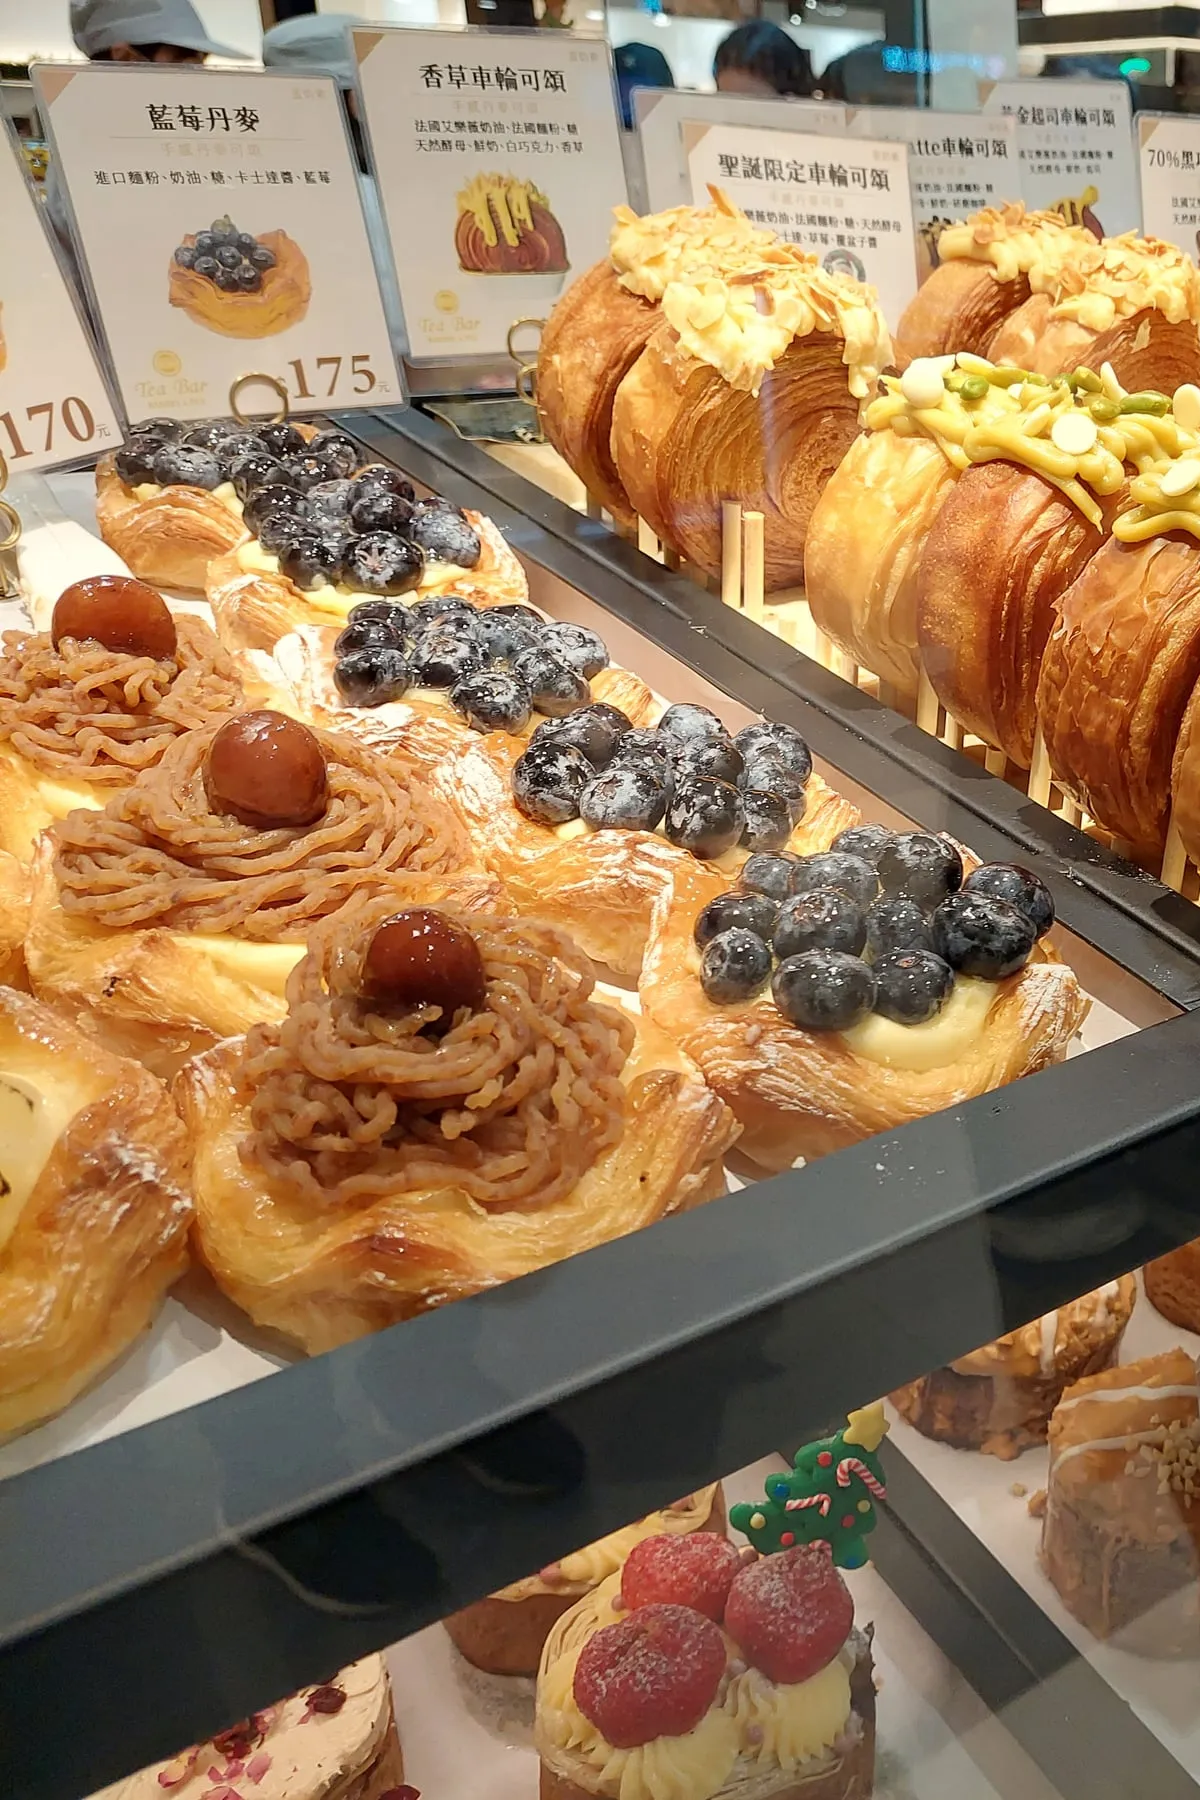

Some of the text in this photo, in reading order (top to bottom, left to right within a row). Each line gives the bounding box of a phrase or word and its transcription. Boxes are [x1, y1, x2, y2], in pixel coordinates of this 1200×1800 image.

[418, 63, 567, 93] 香草車輪可頌
[145, 103, 260, 133] 藍莓丹麥
[718, 154, 890, 192] 聖誕限定車輪可頌
